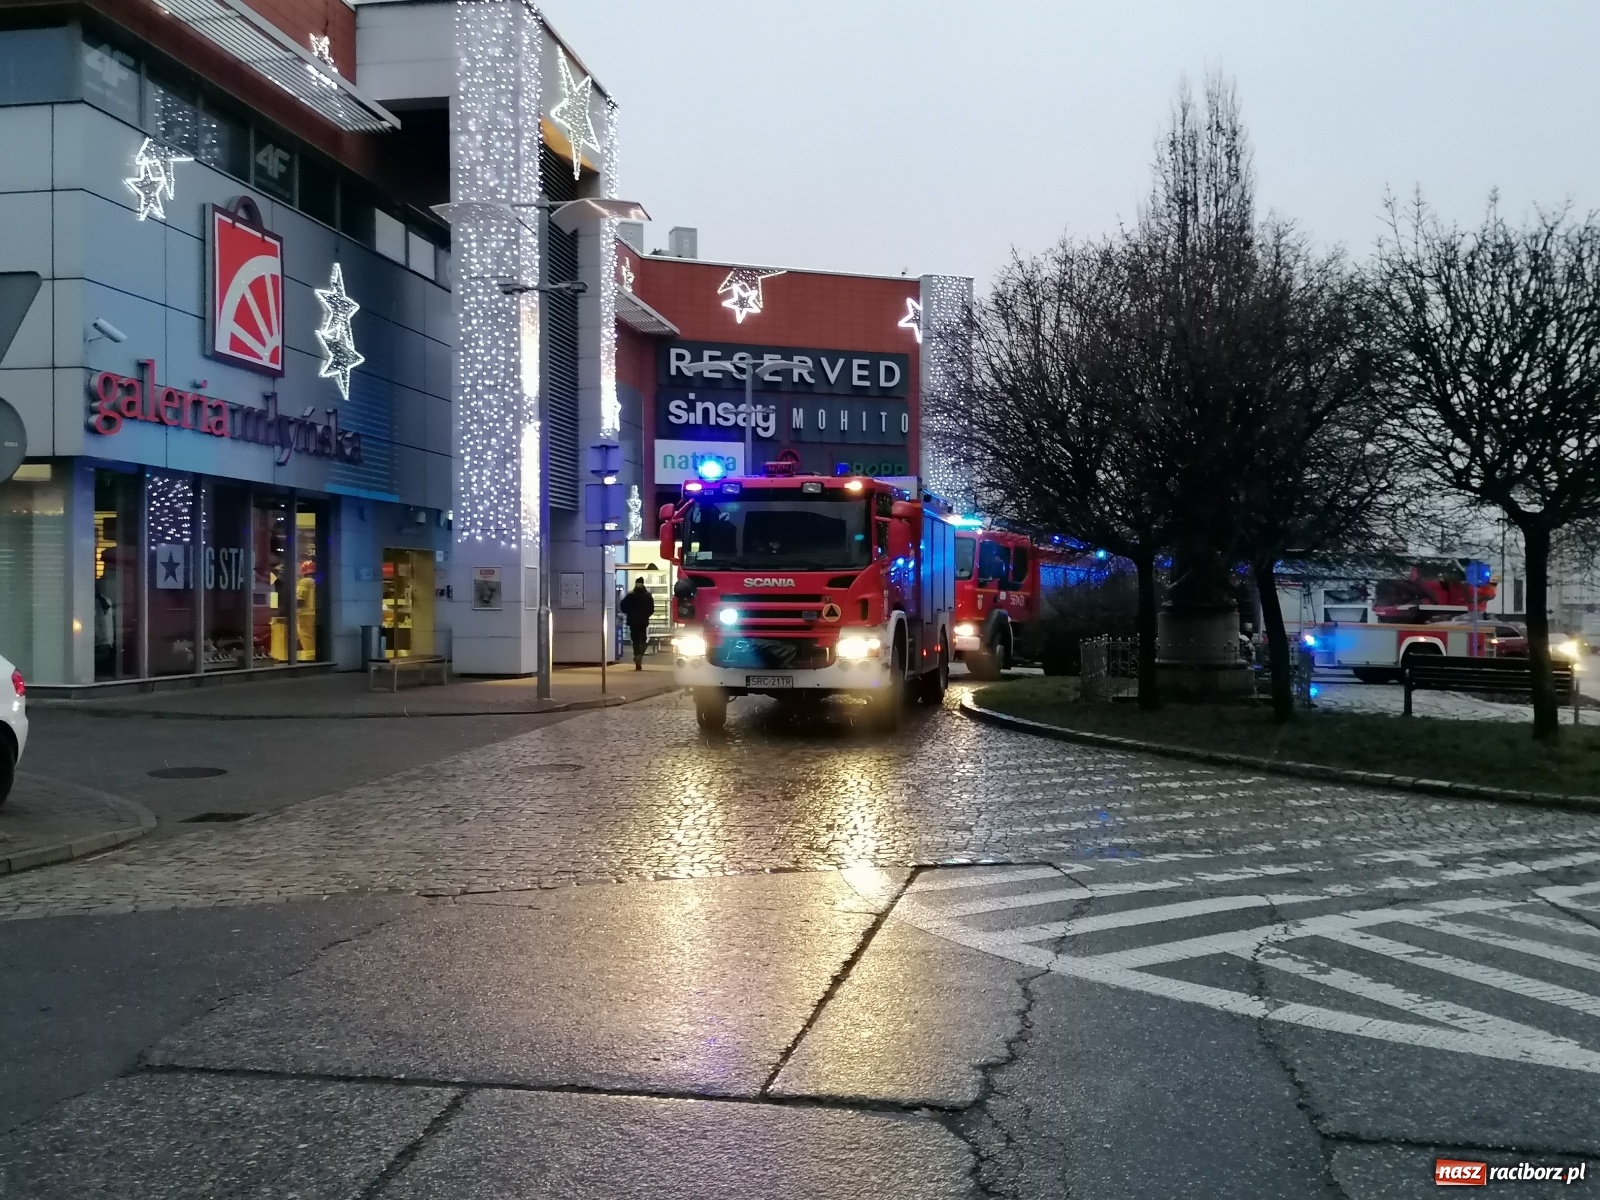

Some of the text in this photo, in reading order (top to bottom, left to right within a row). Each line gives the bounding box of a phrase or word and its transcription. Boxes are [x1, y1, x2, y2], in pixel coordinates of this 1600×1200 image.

[85, 43, 135, 88] 4F
[255, 143, 291, 180] 4F
[669, 348, 901, 388] RESERVED
[92, 359, 231, 435] galeria
[668, 393, 776, 438] sinsay
[792, 408, 909, 434] MOHITO
[743, 578, 796, 588] SCANIA
[750, 677, 791, 687] SRC 21TR
